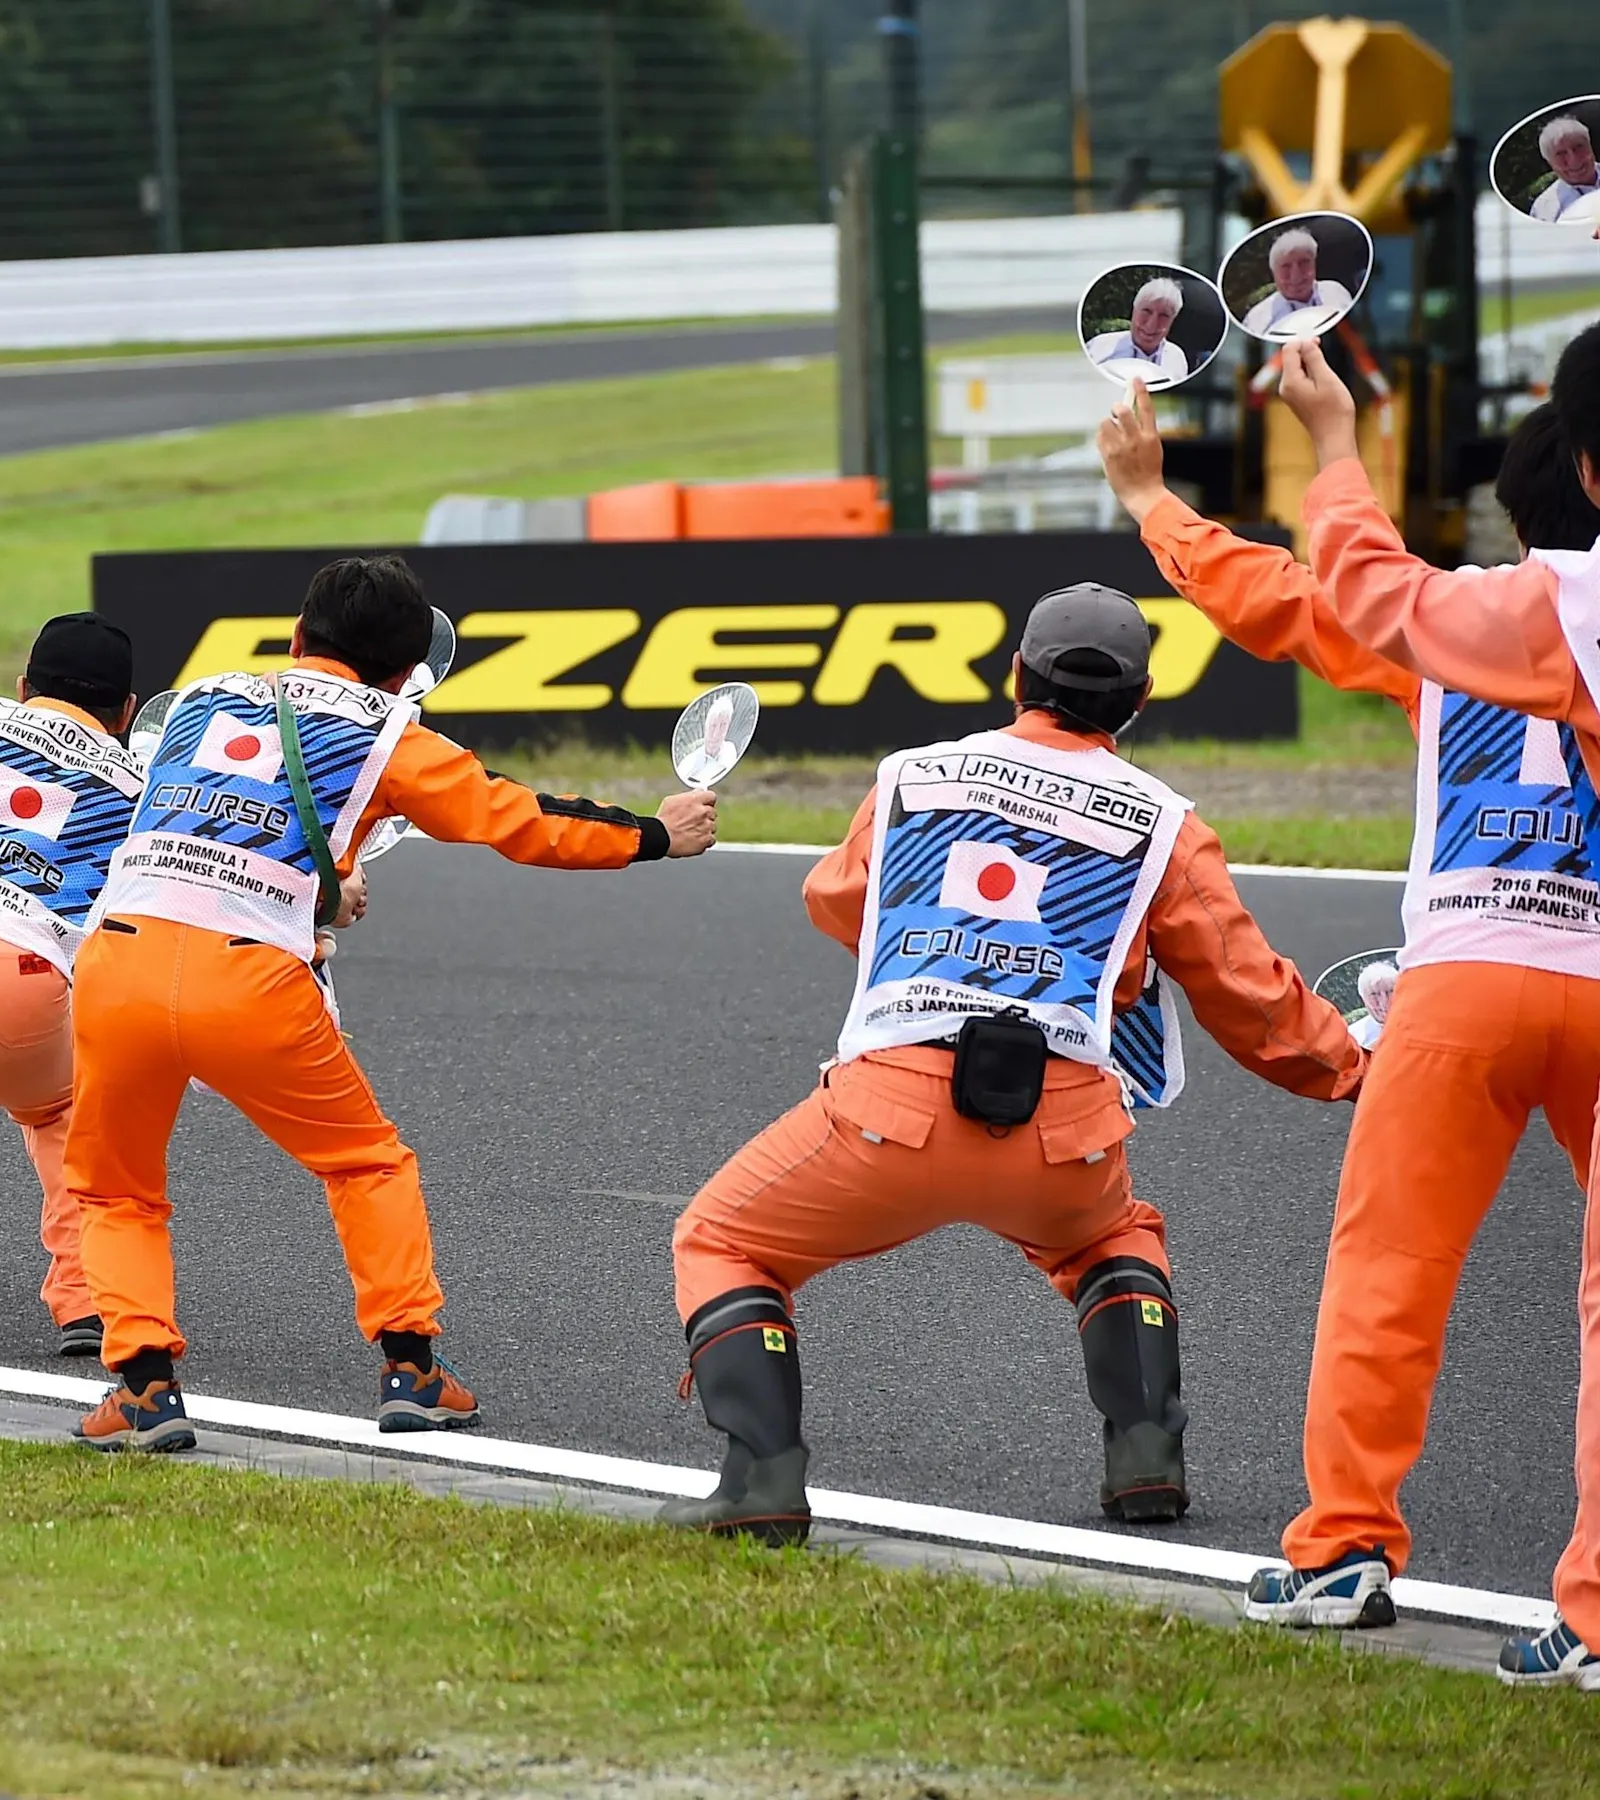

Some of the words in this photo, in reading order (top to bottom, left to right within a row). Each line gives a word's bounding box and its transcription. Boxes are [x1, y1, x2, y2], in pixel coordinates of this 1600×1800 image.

[152, 784, 291, 837] COURSE
[966, 761, 1075, 802] JPN1123
[1090, 795, 1154, 827] 2016
[967, 790, 995, 806] FIRE
[998, 796, 1059, 827] MARSHAL
[1477, 807, 1584, 849] COU
[150, 838, 174, 852] 2016
[177, 841, 237, 868] FORMULA
[241, 858, 248, 871] 1
[153, 855, 216, 878] JAPANESE
[218, 869, 264, 893] GRAND
[266, 885, 296, 907] PRIX
[1492, 877, 1531, 893] 2016
[1536, 879, 1600, 908] FORMUL
[1428, 895, 1501, 913] EMIRATES
[1505, 895, 1590, 923] JAPANESE
[900, 927, 1064, 979] COURSE
[907, 983, 940, 997] 2016
[1054, 1027, 1088, 1047] PRIX
